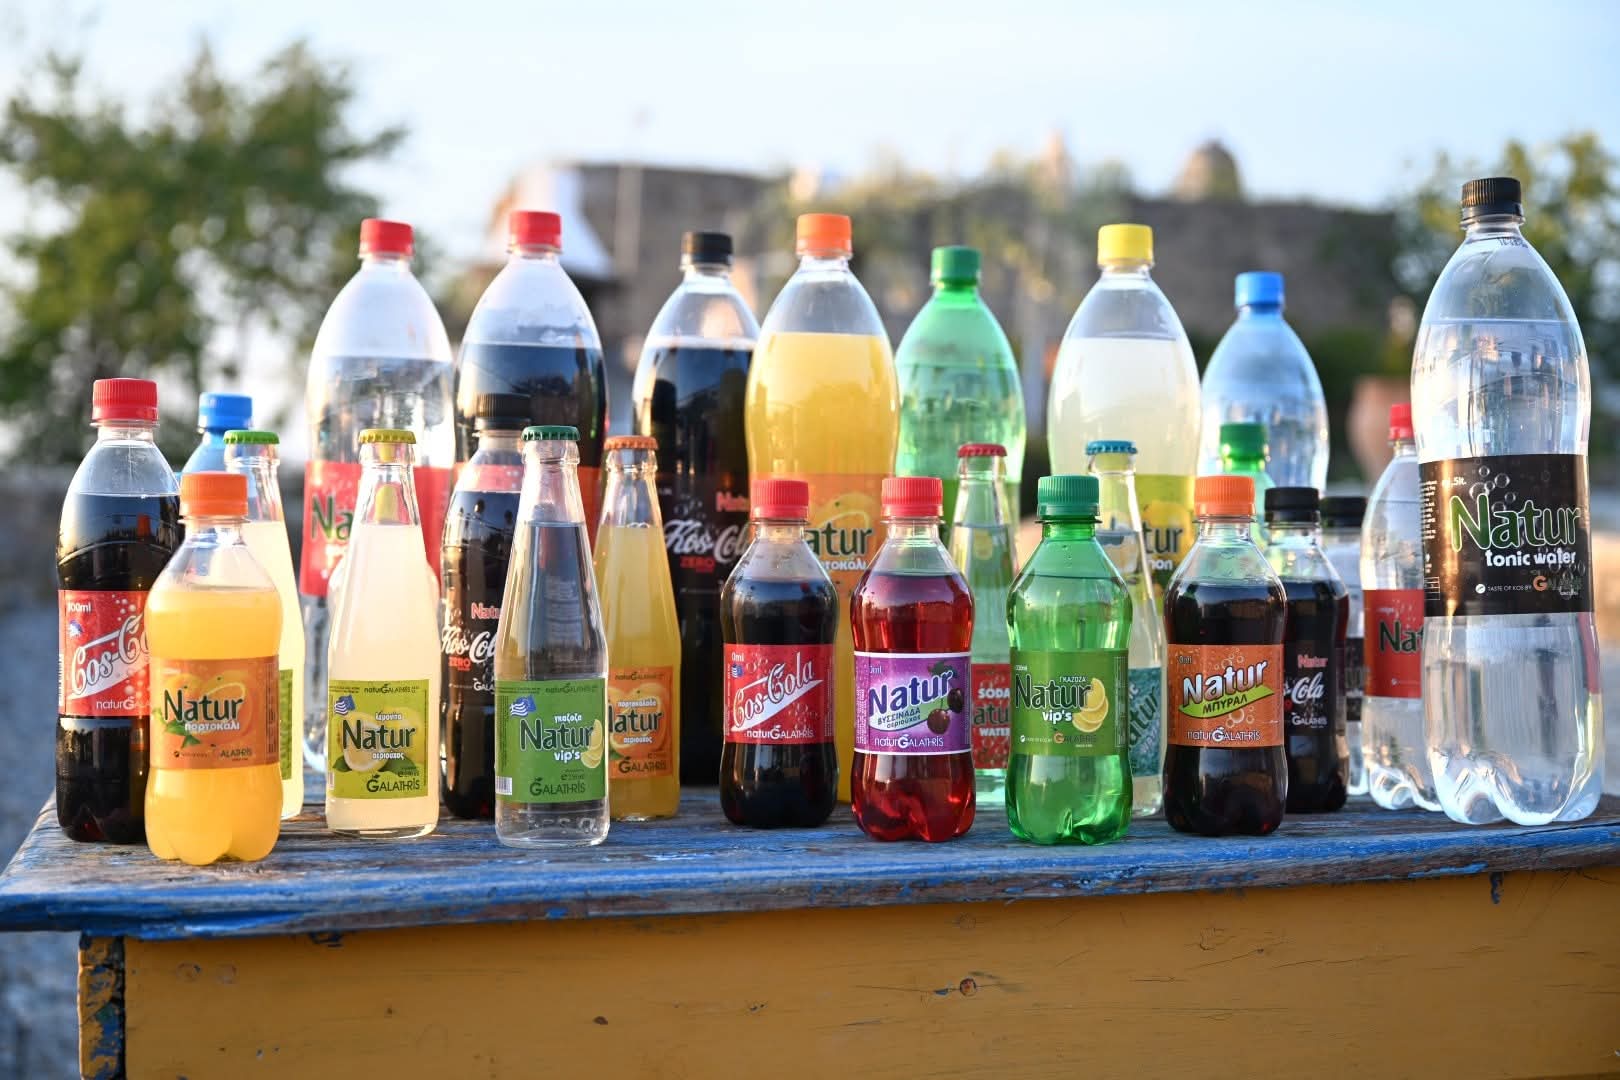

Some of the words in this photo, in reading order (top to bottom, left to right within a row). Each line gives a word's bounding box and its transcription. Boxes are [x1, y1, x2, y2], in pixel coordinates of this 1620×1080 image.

[804, 521, 873, 556] atur
[1142, 521, 1183, 554] tur
[1449, 494, 1581, 552] Natur
[1485, 550, 1531, 567] tonic
[1533, 548, 1576, 564] water
[67, 602, 92, 612] 00ml
[71, 613, 150, 695] Cos-Co
[733, 651, 814, 728] Cos-Cola
[868, 671, 953, 717] Natur
[978, 688, 1011, 699] SODA
[1015, 674, 1092, 709] Natur
[1183, 661, 1268, 708] Natur
[164, 689, 244, 722] Natur
[877, 707, 921, 725] ΒΥΣΣΙΝΑΔΑ
[973, 703, 1010, 725] atu
[1042, 710, 1073, 724] vip's
[1202, 694, 1248, 714] ΜΠΥΡΑΛ
[342, 719, 416, 750] Natur
[520, 718, 594, 751] Natur
[554, 750, 580, 763] vip's
